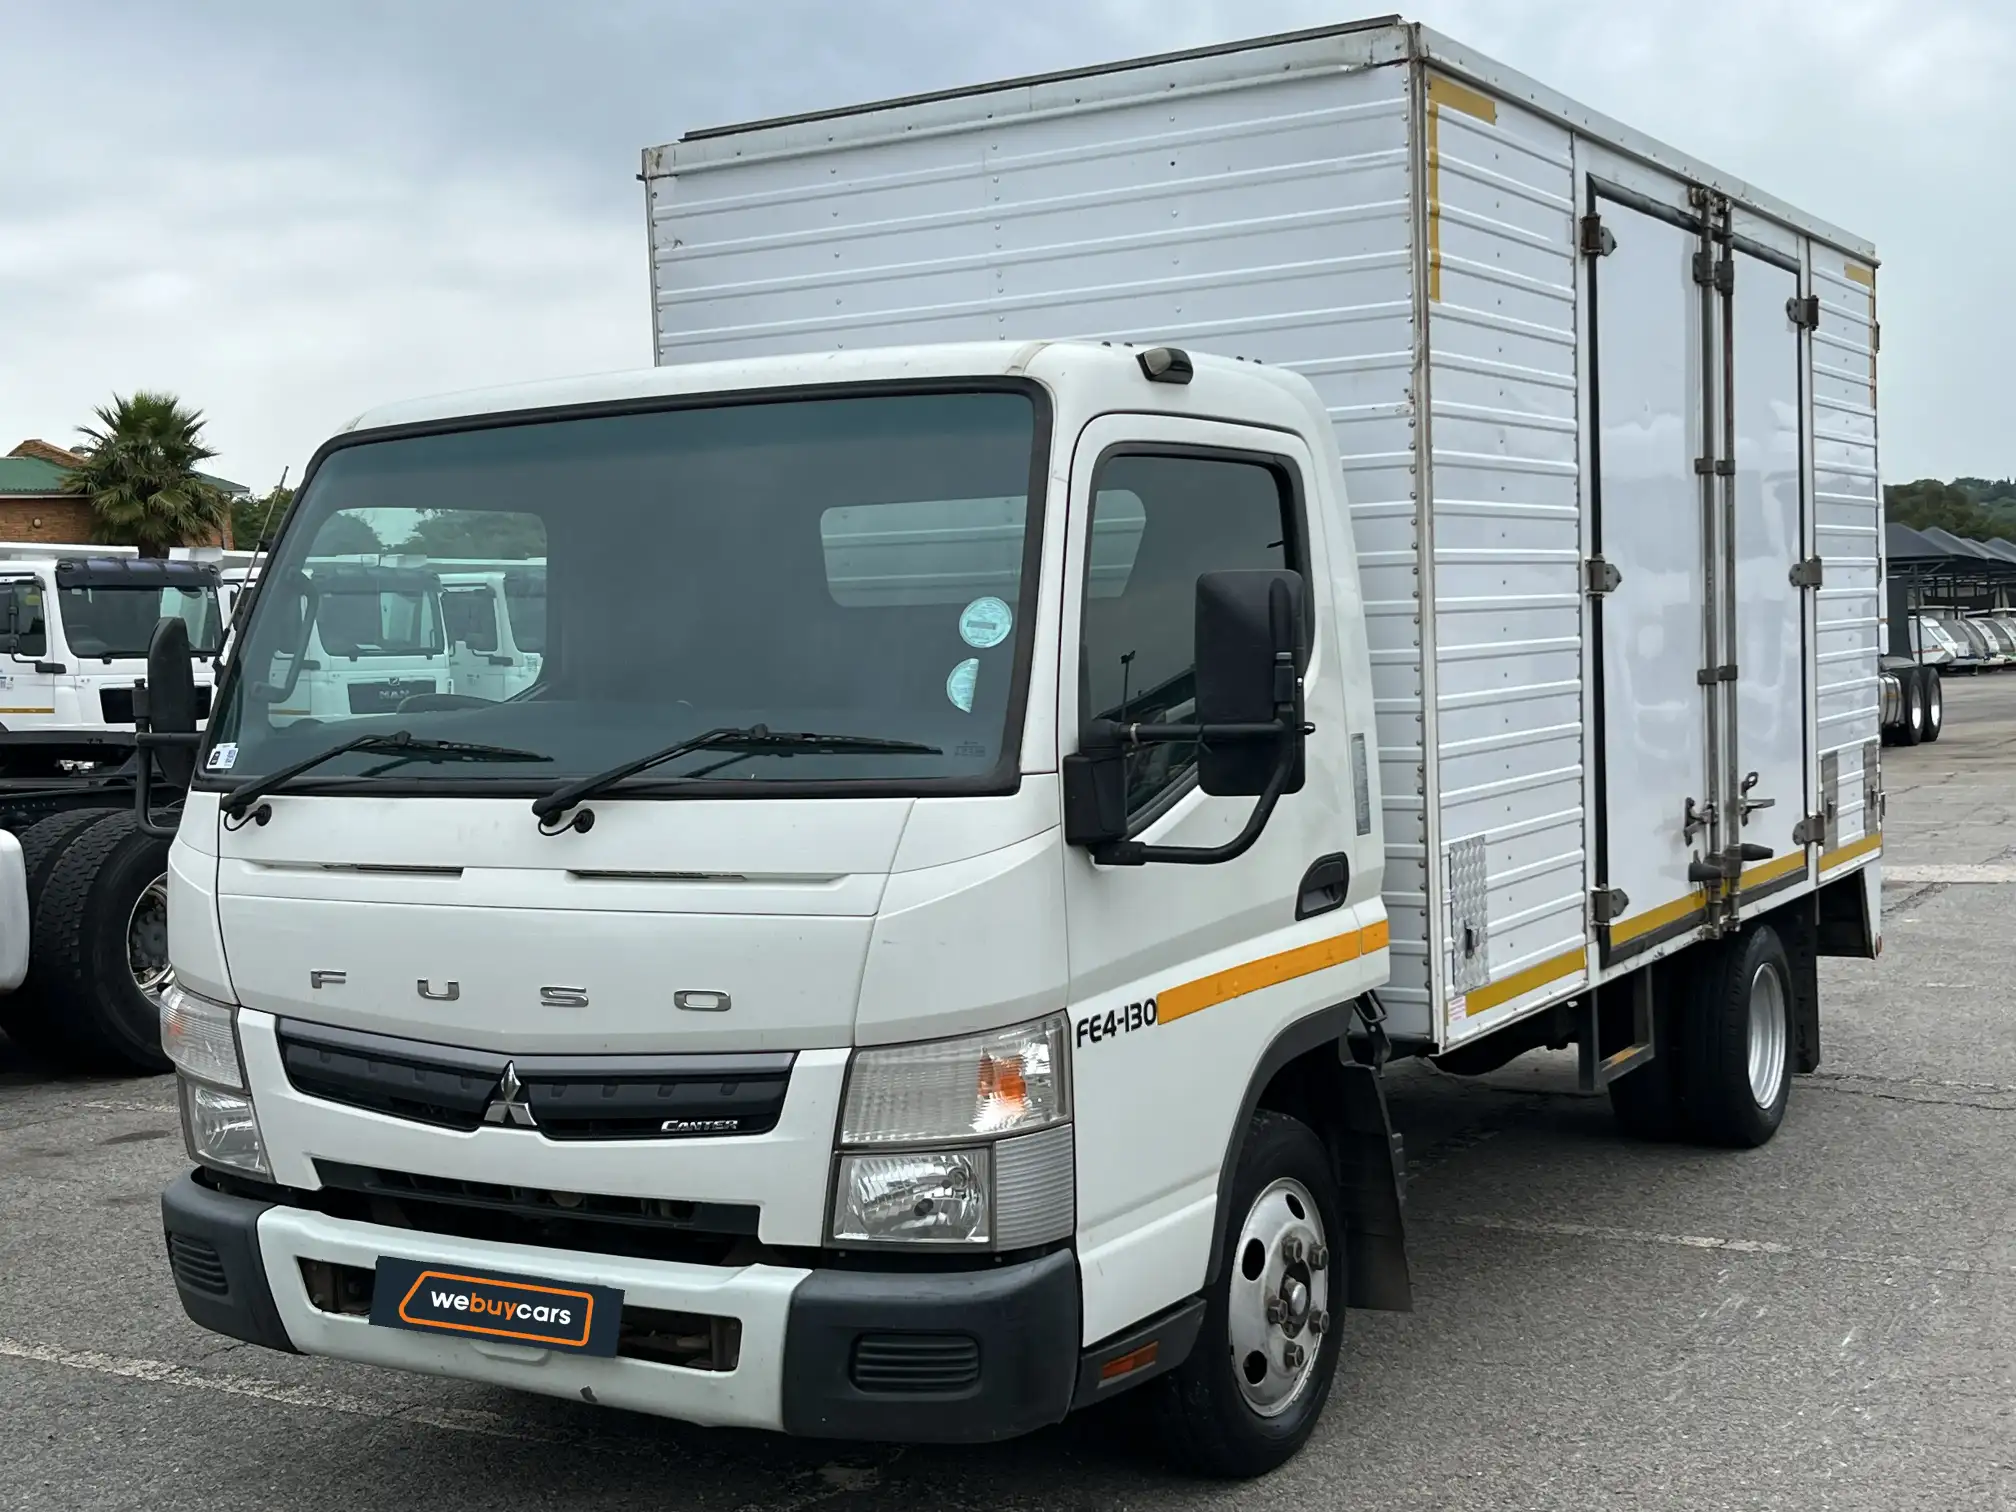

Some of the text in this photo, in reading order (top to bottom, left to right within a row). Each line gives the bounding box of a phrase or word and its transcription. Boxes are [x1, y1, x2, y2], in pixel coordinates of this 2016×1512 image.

[311, 969, 731, 1012] FUSO
[1076, 998, 1157, 1048] FE4-130
[430, 1290, 571, 1325] webuycars
